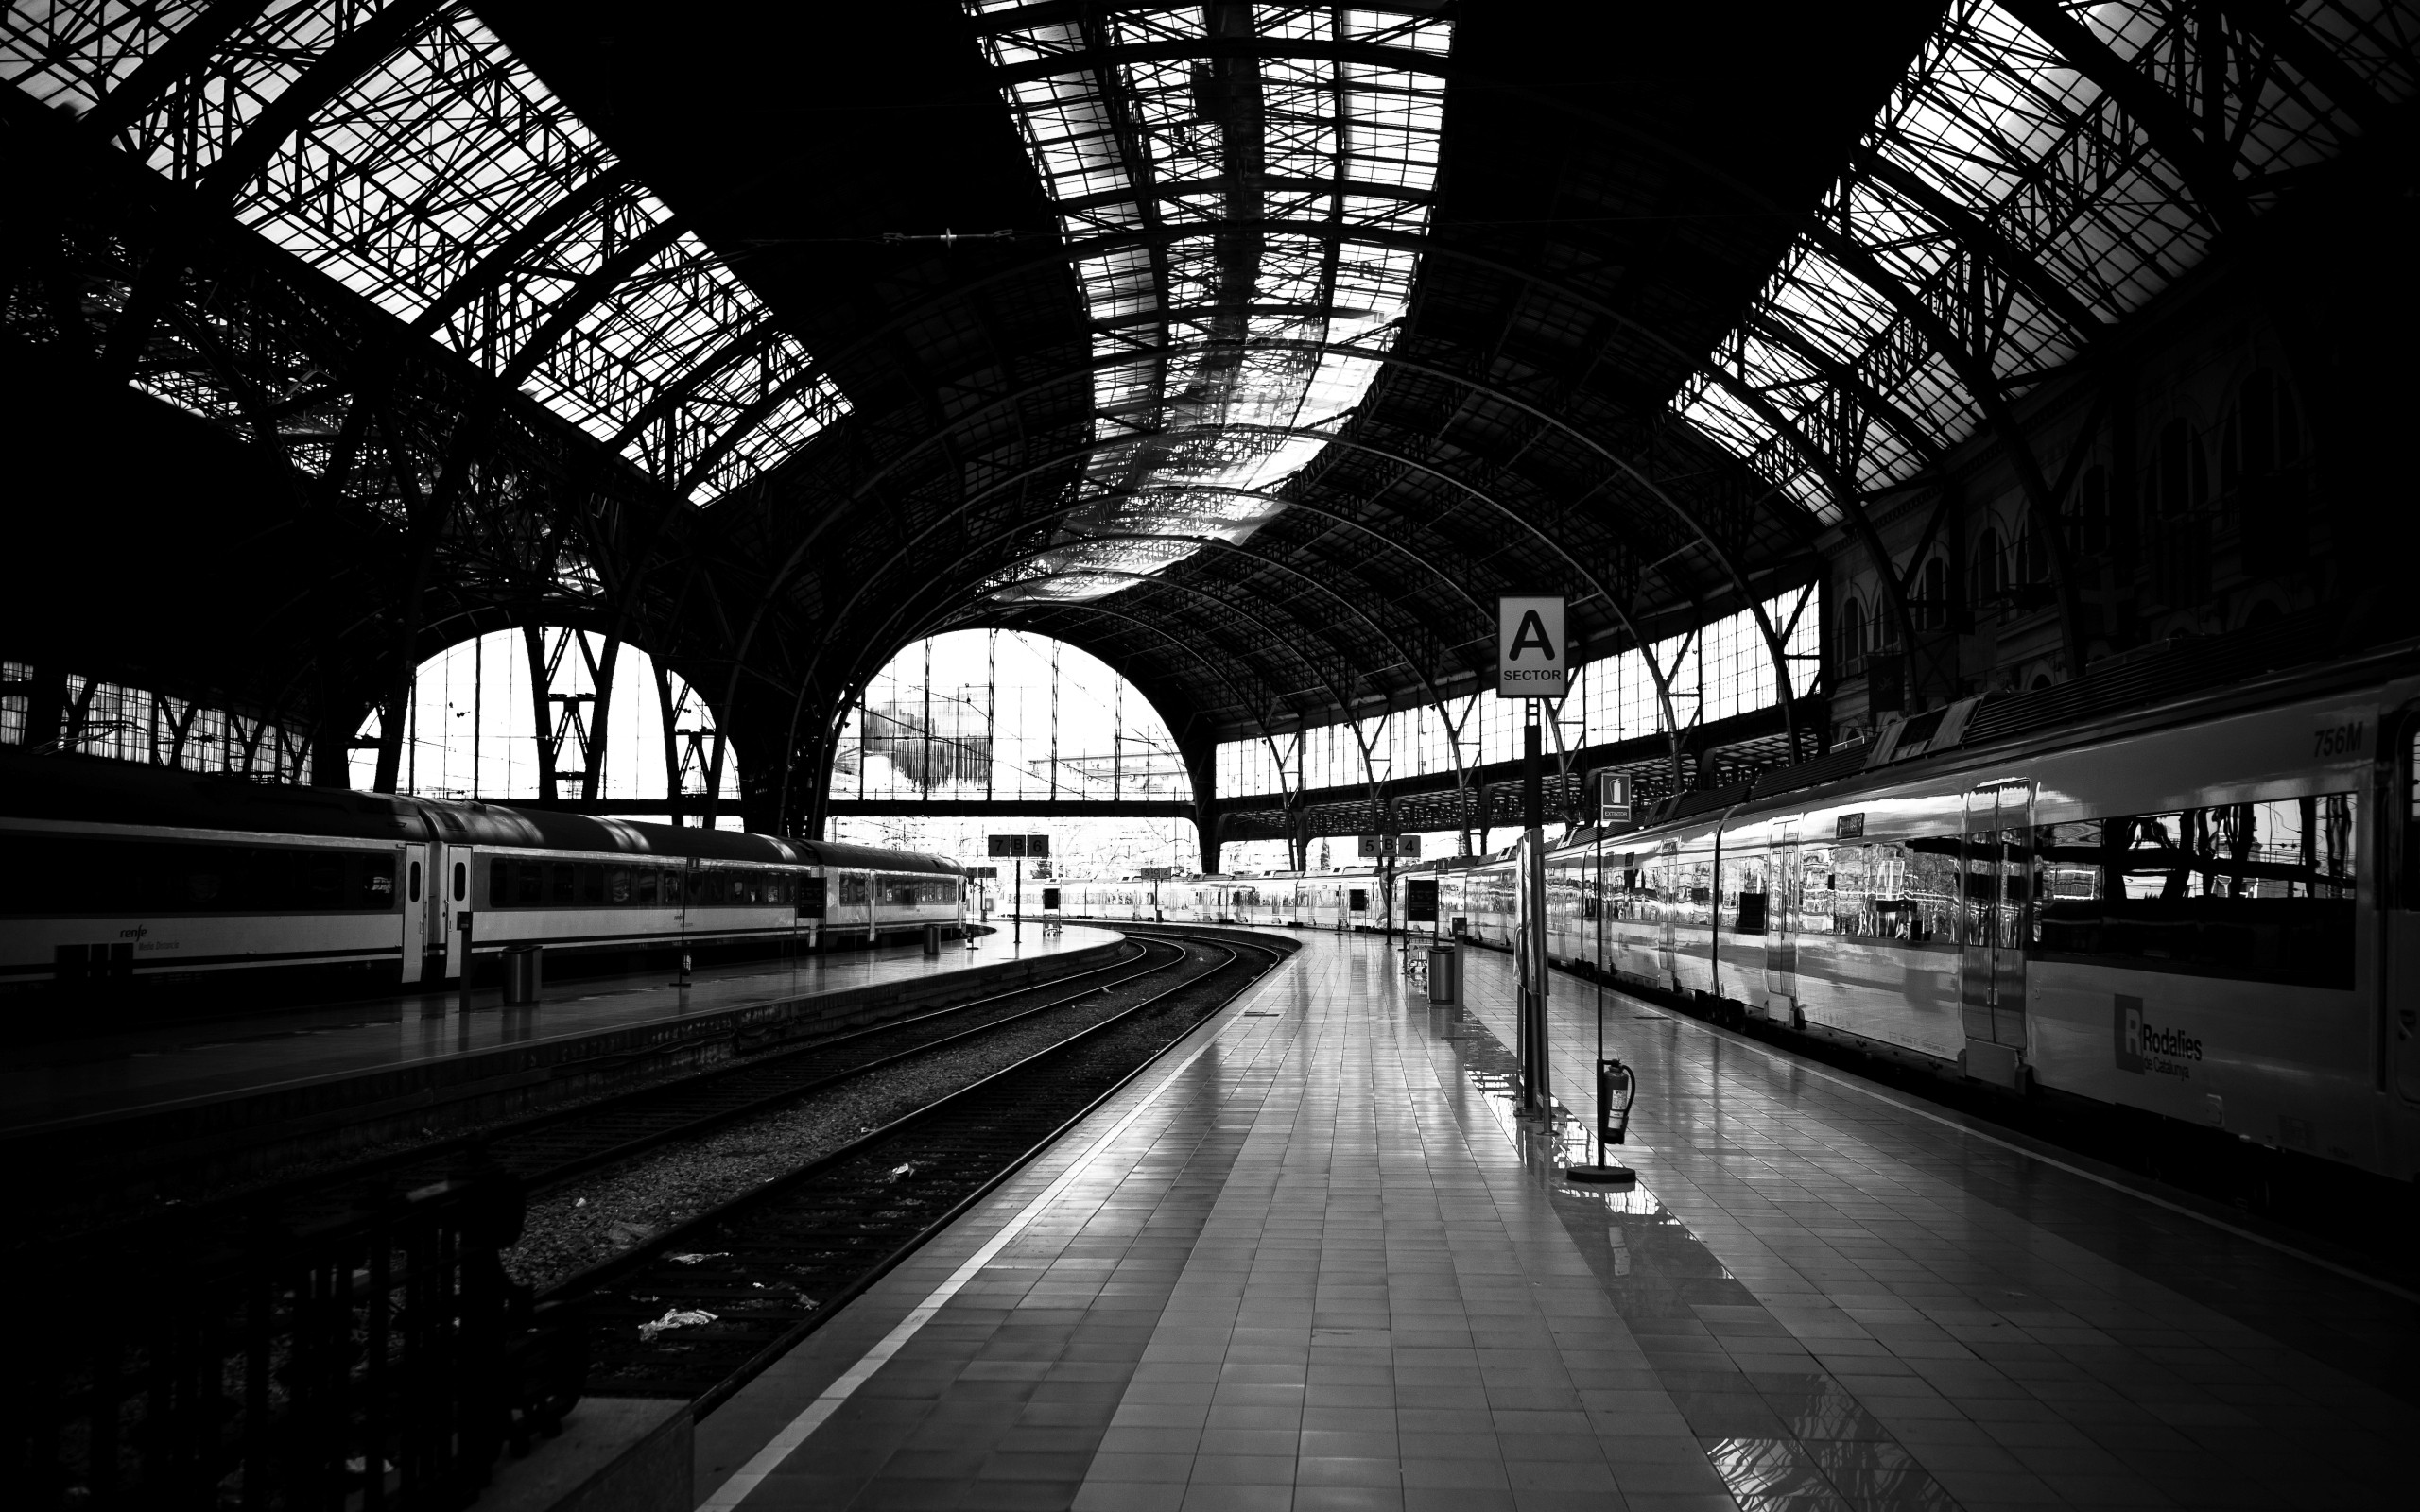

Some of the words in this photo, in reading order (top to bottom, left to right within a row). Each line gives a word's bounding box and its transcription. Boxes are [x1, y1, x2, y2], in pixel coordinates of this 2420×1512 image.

[1509, 610, 1555, 661] A
[1503, 670, 1562, 681] SECTOR
[2314, 721, 2363, 758] 756M
[995, 839, 1004, 852] 7
[1013, 838, 1023, 850] B
[1033, 839, 1042, 852] 6
[1365, 839, 1374, 852] 5
[1384, 838, 1394, 850] B
[1404, 839, 1414, 852] 4
[119, 924, 147, 942] renfe
[2125, 1007, 2142, 1057] R
[2143, 1023, 2202, 1061] Rodalies
[2154, 1056, 2190, 1082] Catalunya
